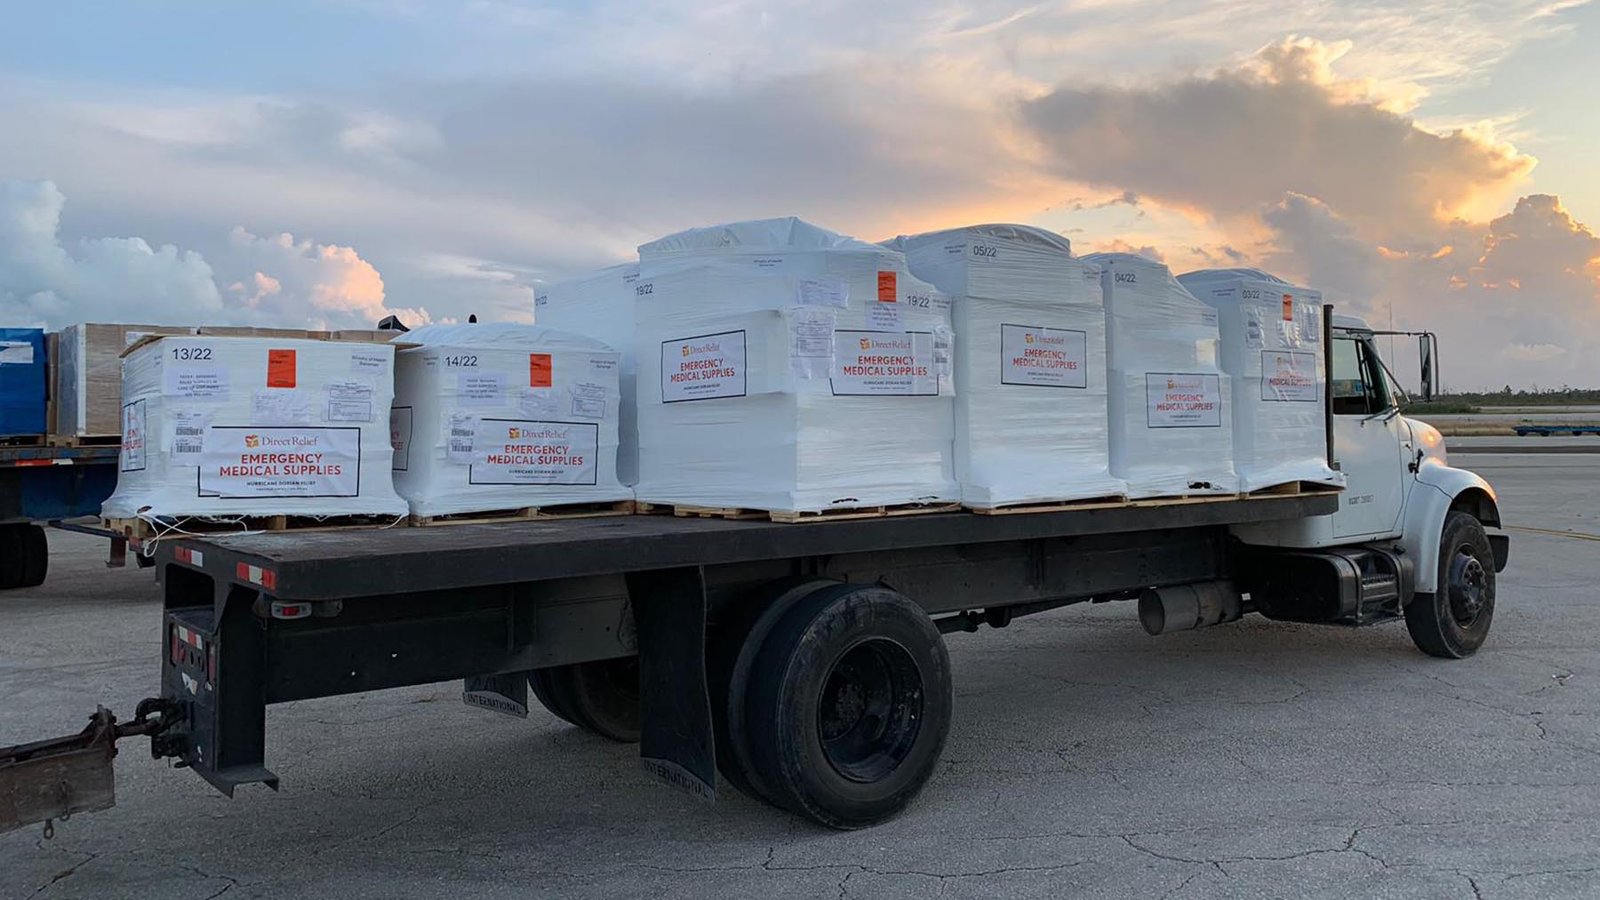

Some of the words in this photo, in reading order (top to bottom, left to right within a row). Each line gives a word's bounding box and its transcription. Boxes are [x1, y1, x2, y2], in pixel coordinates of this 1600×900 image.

[973, 246, 997, 257] 05/22
[172, 348, 212, 360] 13/22
[858, 355, 915, 365] EMERGENCY
[1024, 348, 1067, 360] EMERGENCY
[445, 355, 478, 367] 14/22
[680, 358, 723, 372] EMERGENCY
[1012, 357, 1044, 368] MEDICAL
[1046, 359, 1077, 370] SUPPLIES
[670, 371, 700, 383] MEDICAL
[702, 367, 735, 380] SUPPLIES
[843, 366, 885, 376] MEDICAL
[887, 366, 928, 376] SUPPLIES
[522, 429, 545, 439] Direct
[545, 430, 567, 440] Relief
[262, 436, 291, 447] Direct
[292, 435, 319, 447] Relief
[504, 444, 569, 455] EMERGENCY
[241, 453, 323, 465] EMERGENCY
[487, 454, 535, 465] MEDICAL
[538, 455, 584, 466] SUPPLIES
[219, 465, 280, 477] MEDICAL
[283, 465, 342, 476] SUPPLIES
[467, 692, 522, 714] INTERNATIONAL
